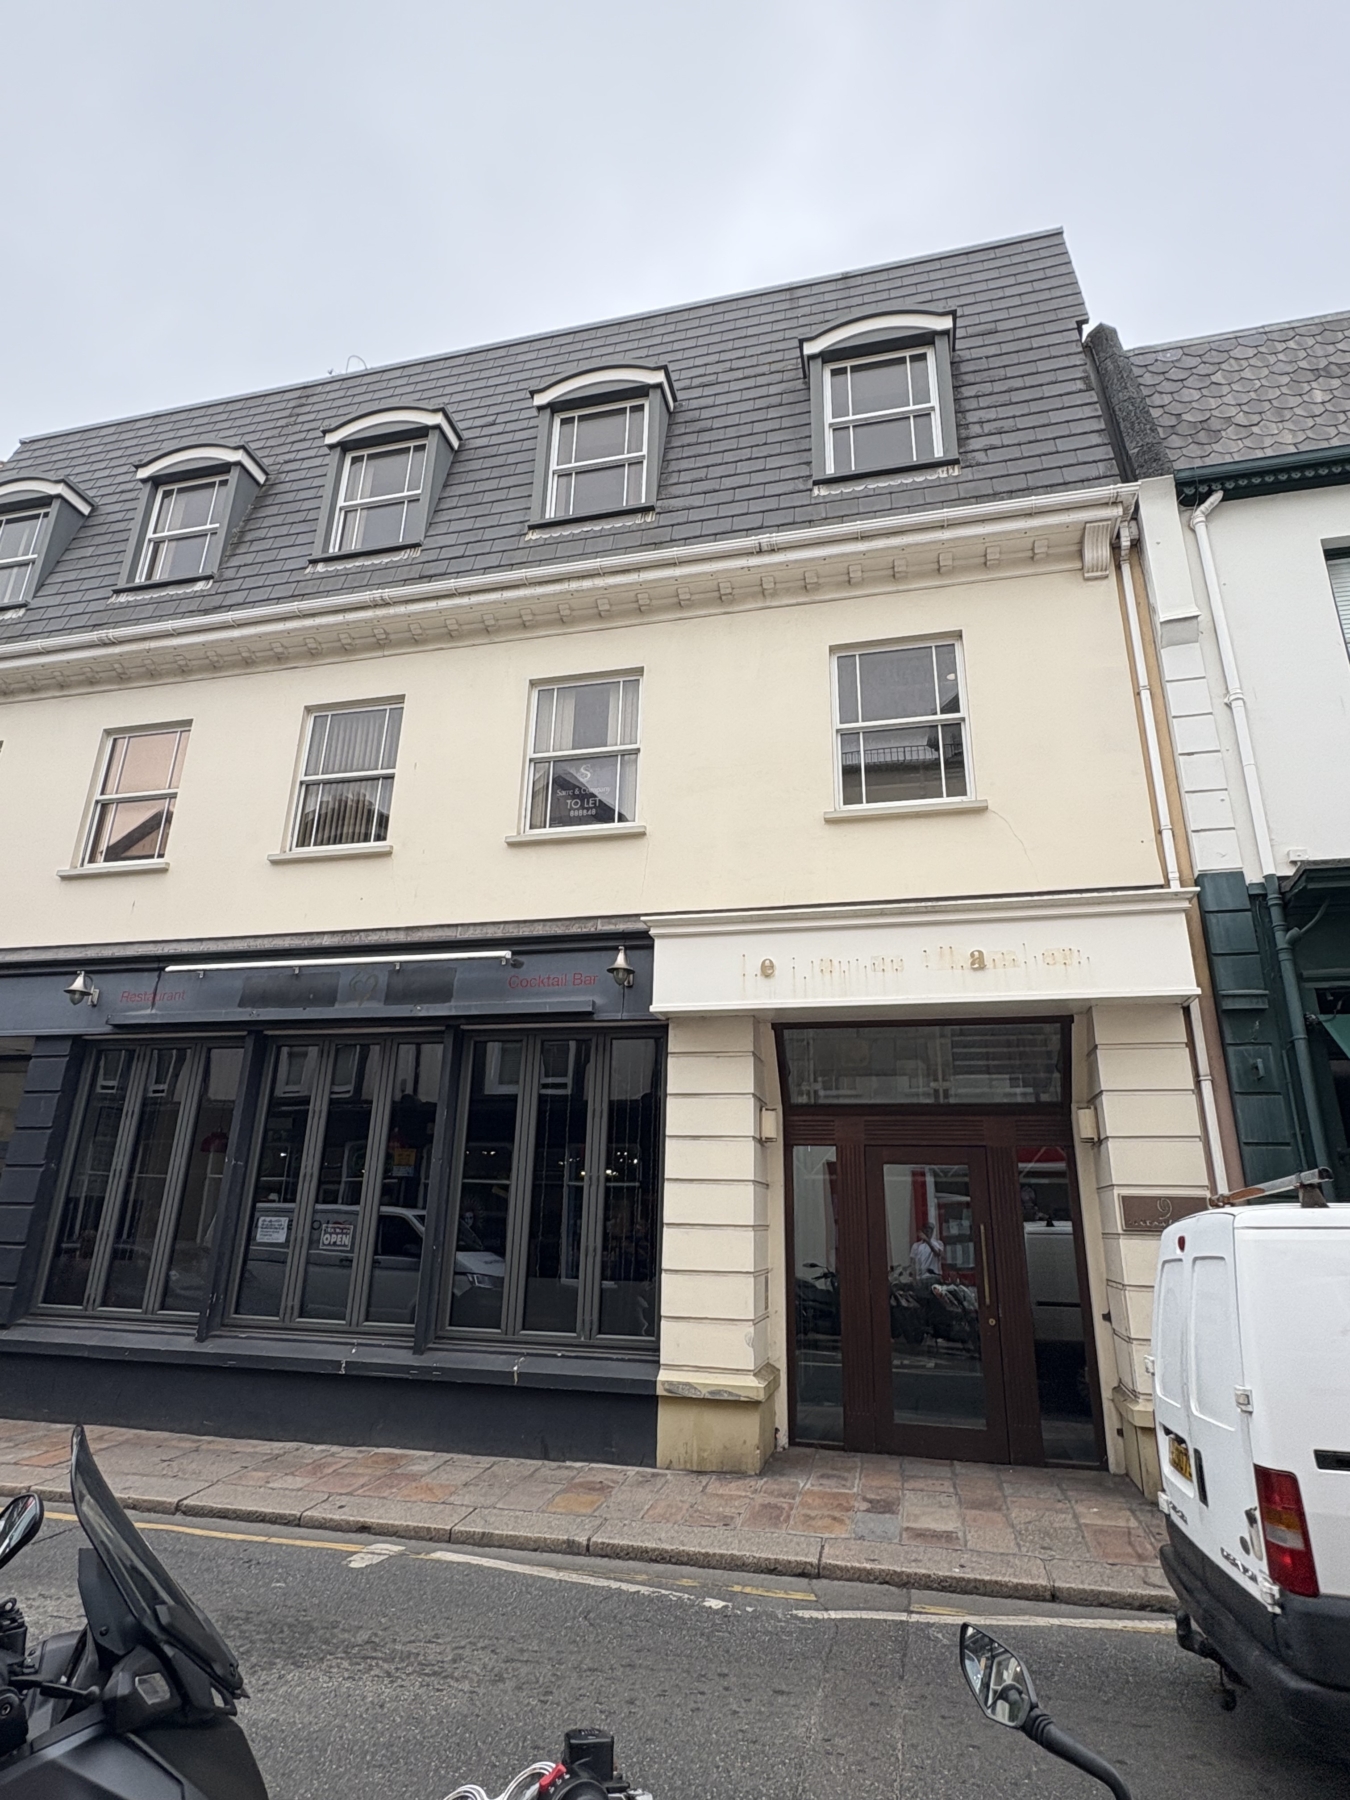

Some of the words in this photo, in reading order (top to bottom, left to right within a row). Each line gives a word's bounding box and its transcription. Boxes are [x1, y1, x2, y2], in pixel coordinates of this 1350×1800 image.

[581, 786, 611, 795] Company
[566, 799, 581, 809] TO
[584, 797, 600, 807] LET
[508, 973, 568, 989] Cocktail
[572, 972, 598, 987] Bar
[119, 990, 187, 1003] Restaurant
[1156, 1198, 1173, 1220] 9
[323, 1233, 350, 1246] OPEN
